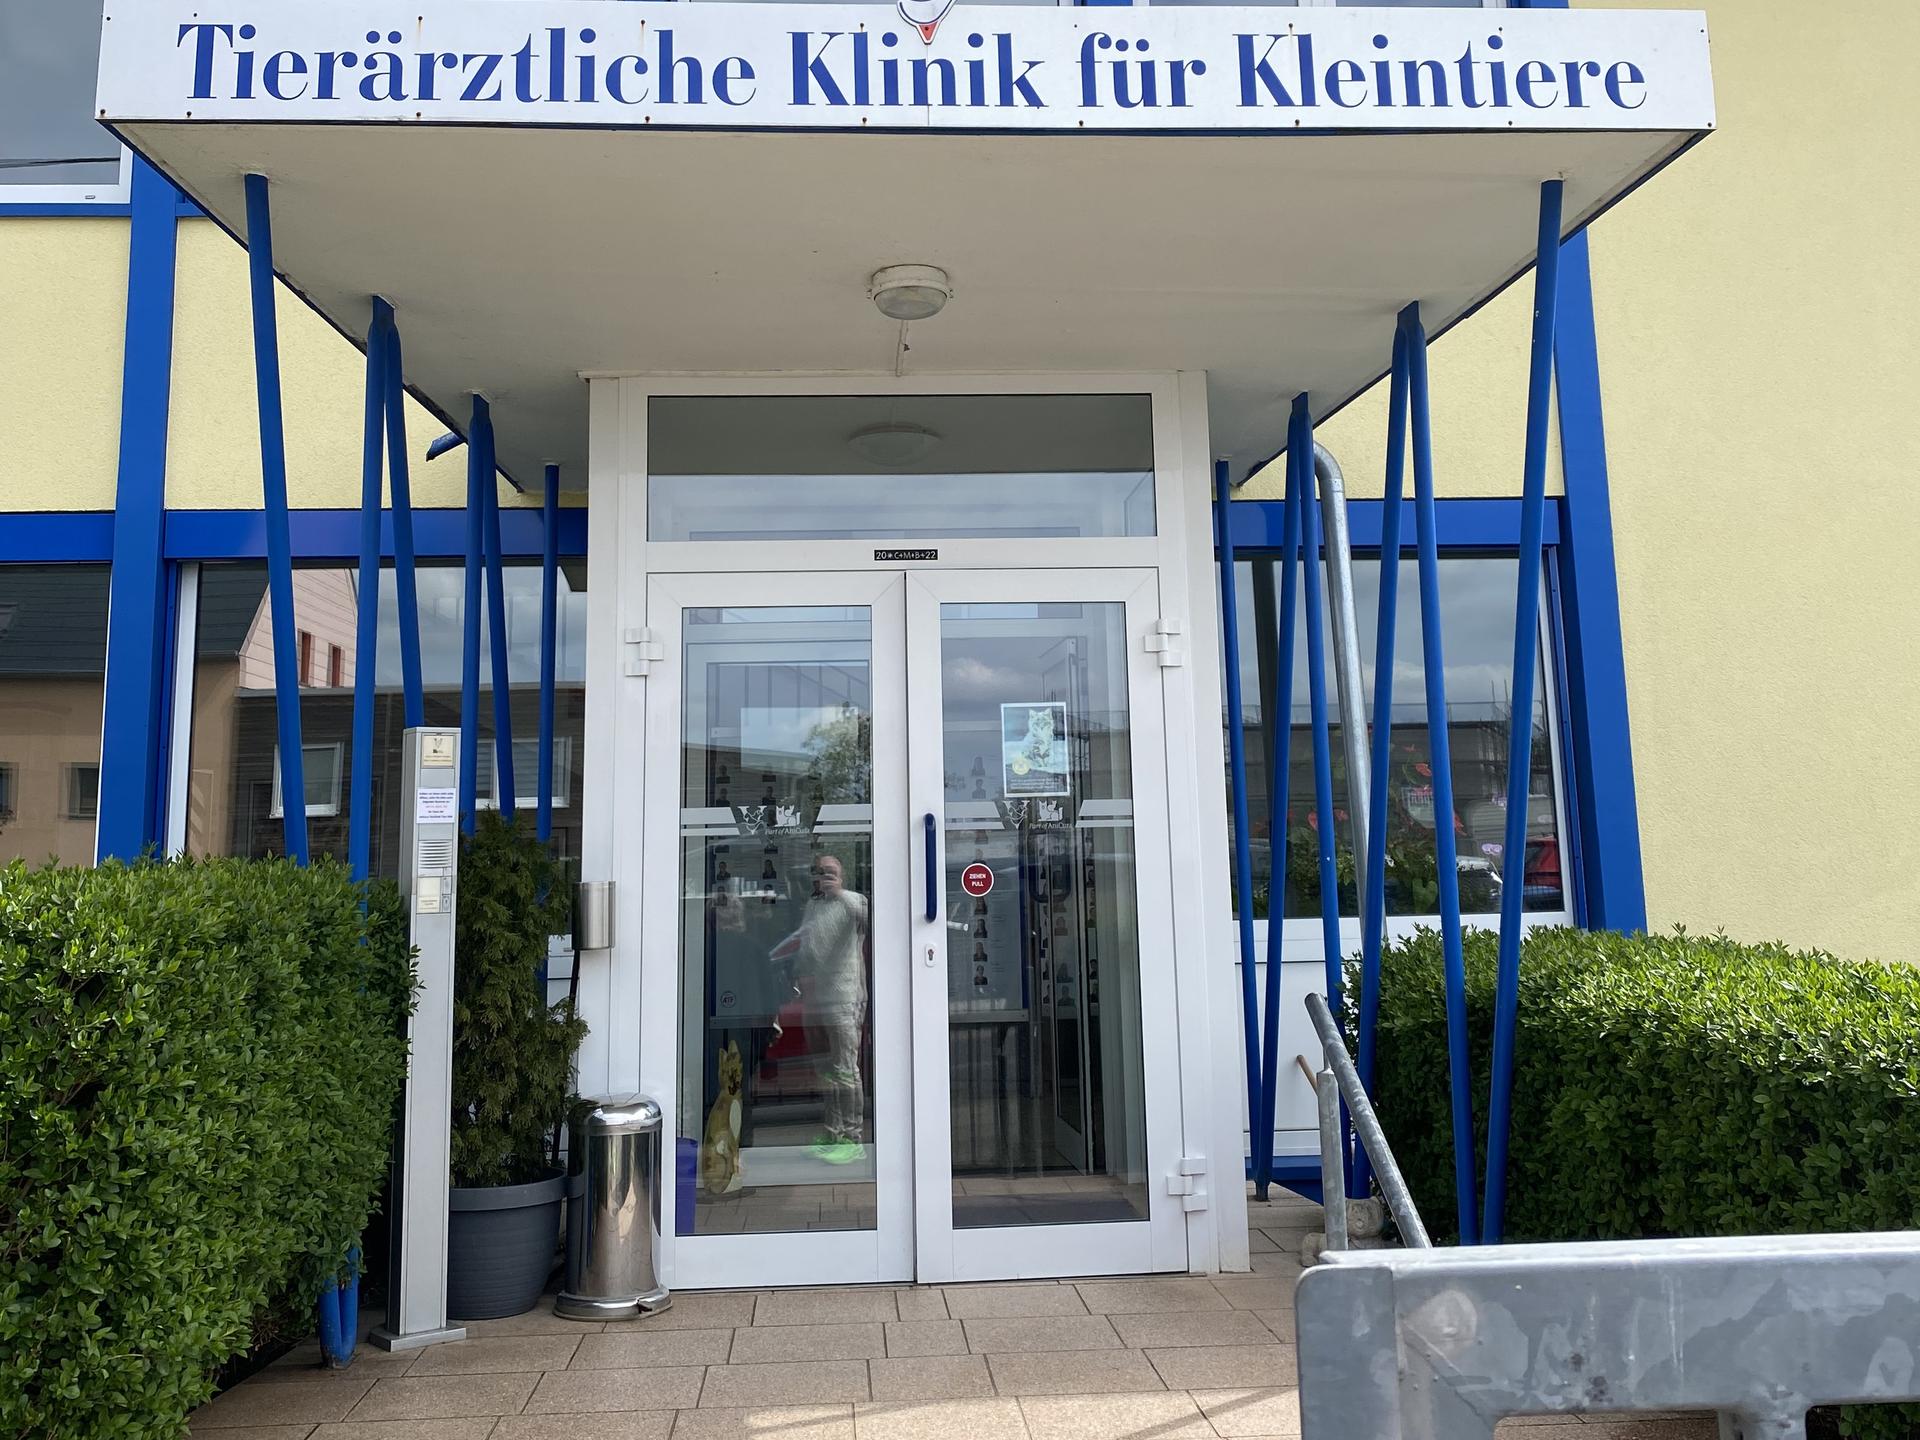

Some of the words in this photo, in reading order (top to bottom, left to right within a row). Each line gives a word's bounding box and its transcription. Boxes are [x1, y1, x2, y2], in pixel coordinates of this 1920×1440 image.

[177, 23, 758, 107] Tierärztliche
[786, 31, 1046, 109] Klinik
[1076, 32, 1208, 109] für
[1235, 33, 1649, 110] Kleintiere
